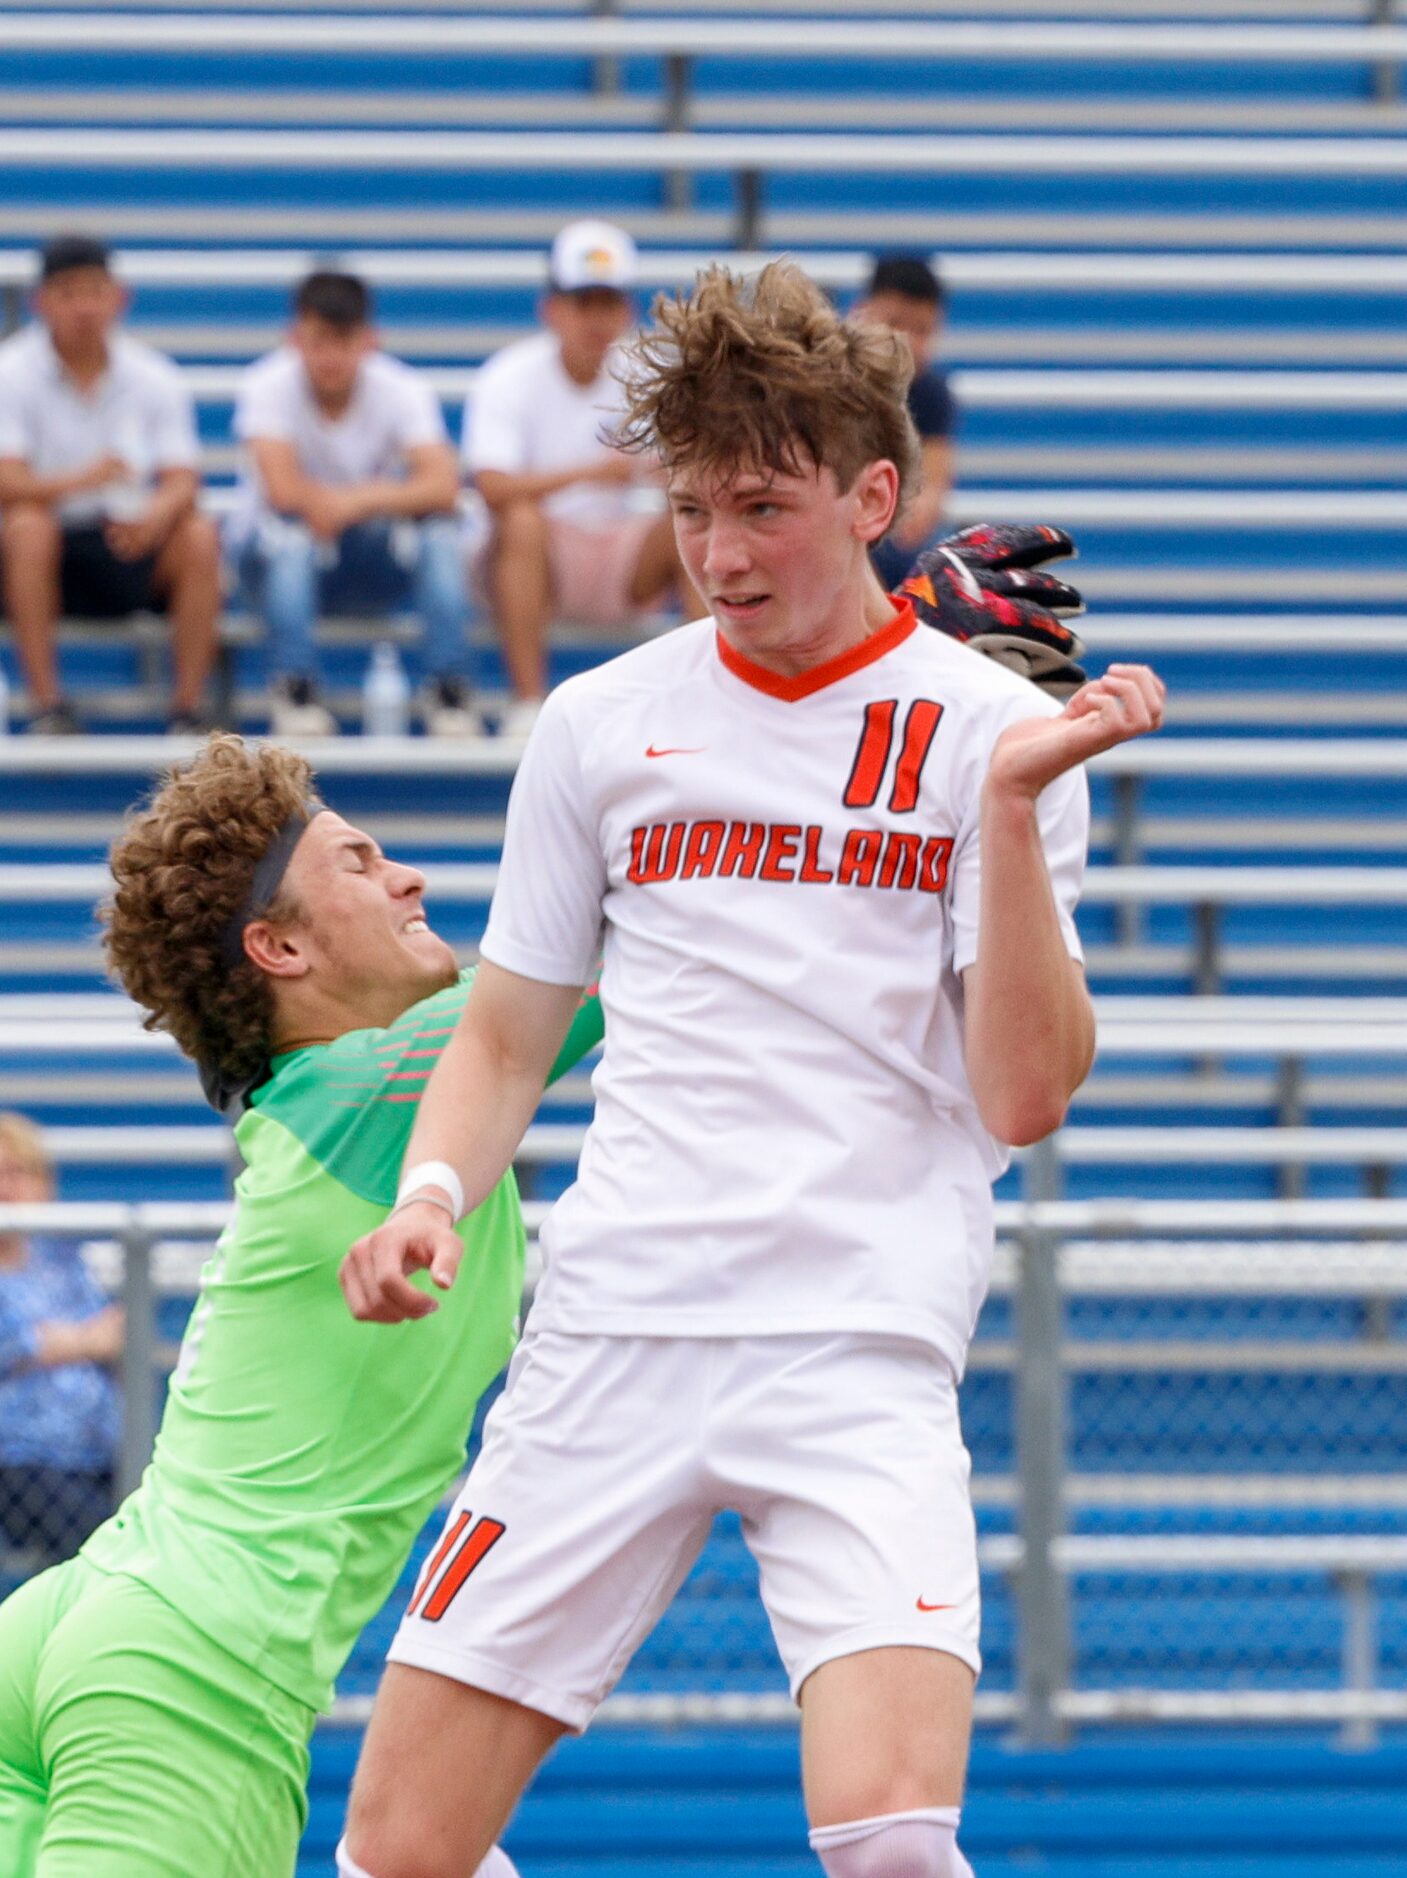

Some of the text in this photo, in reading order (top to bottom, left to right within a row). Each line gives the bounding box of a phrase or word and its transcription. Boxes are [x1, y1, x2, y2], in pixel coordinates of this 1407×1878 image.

[842, 698, 945, 813] 11
[626, 820, 955, 893] WAKELAND
[406, 1509, 506, 1622] 11
